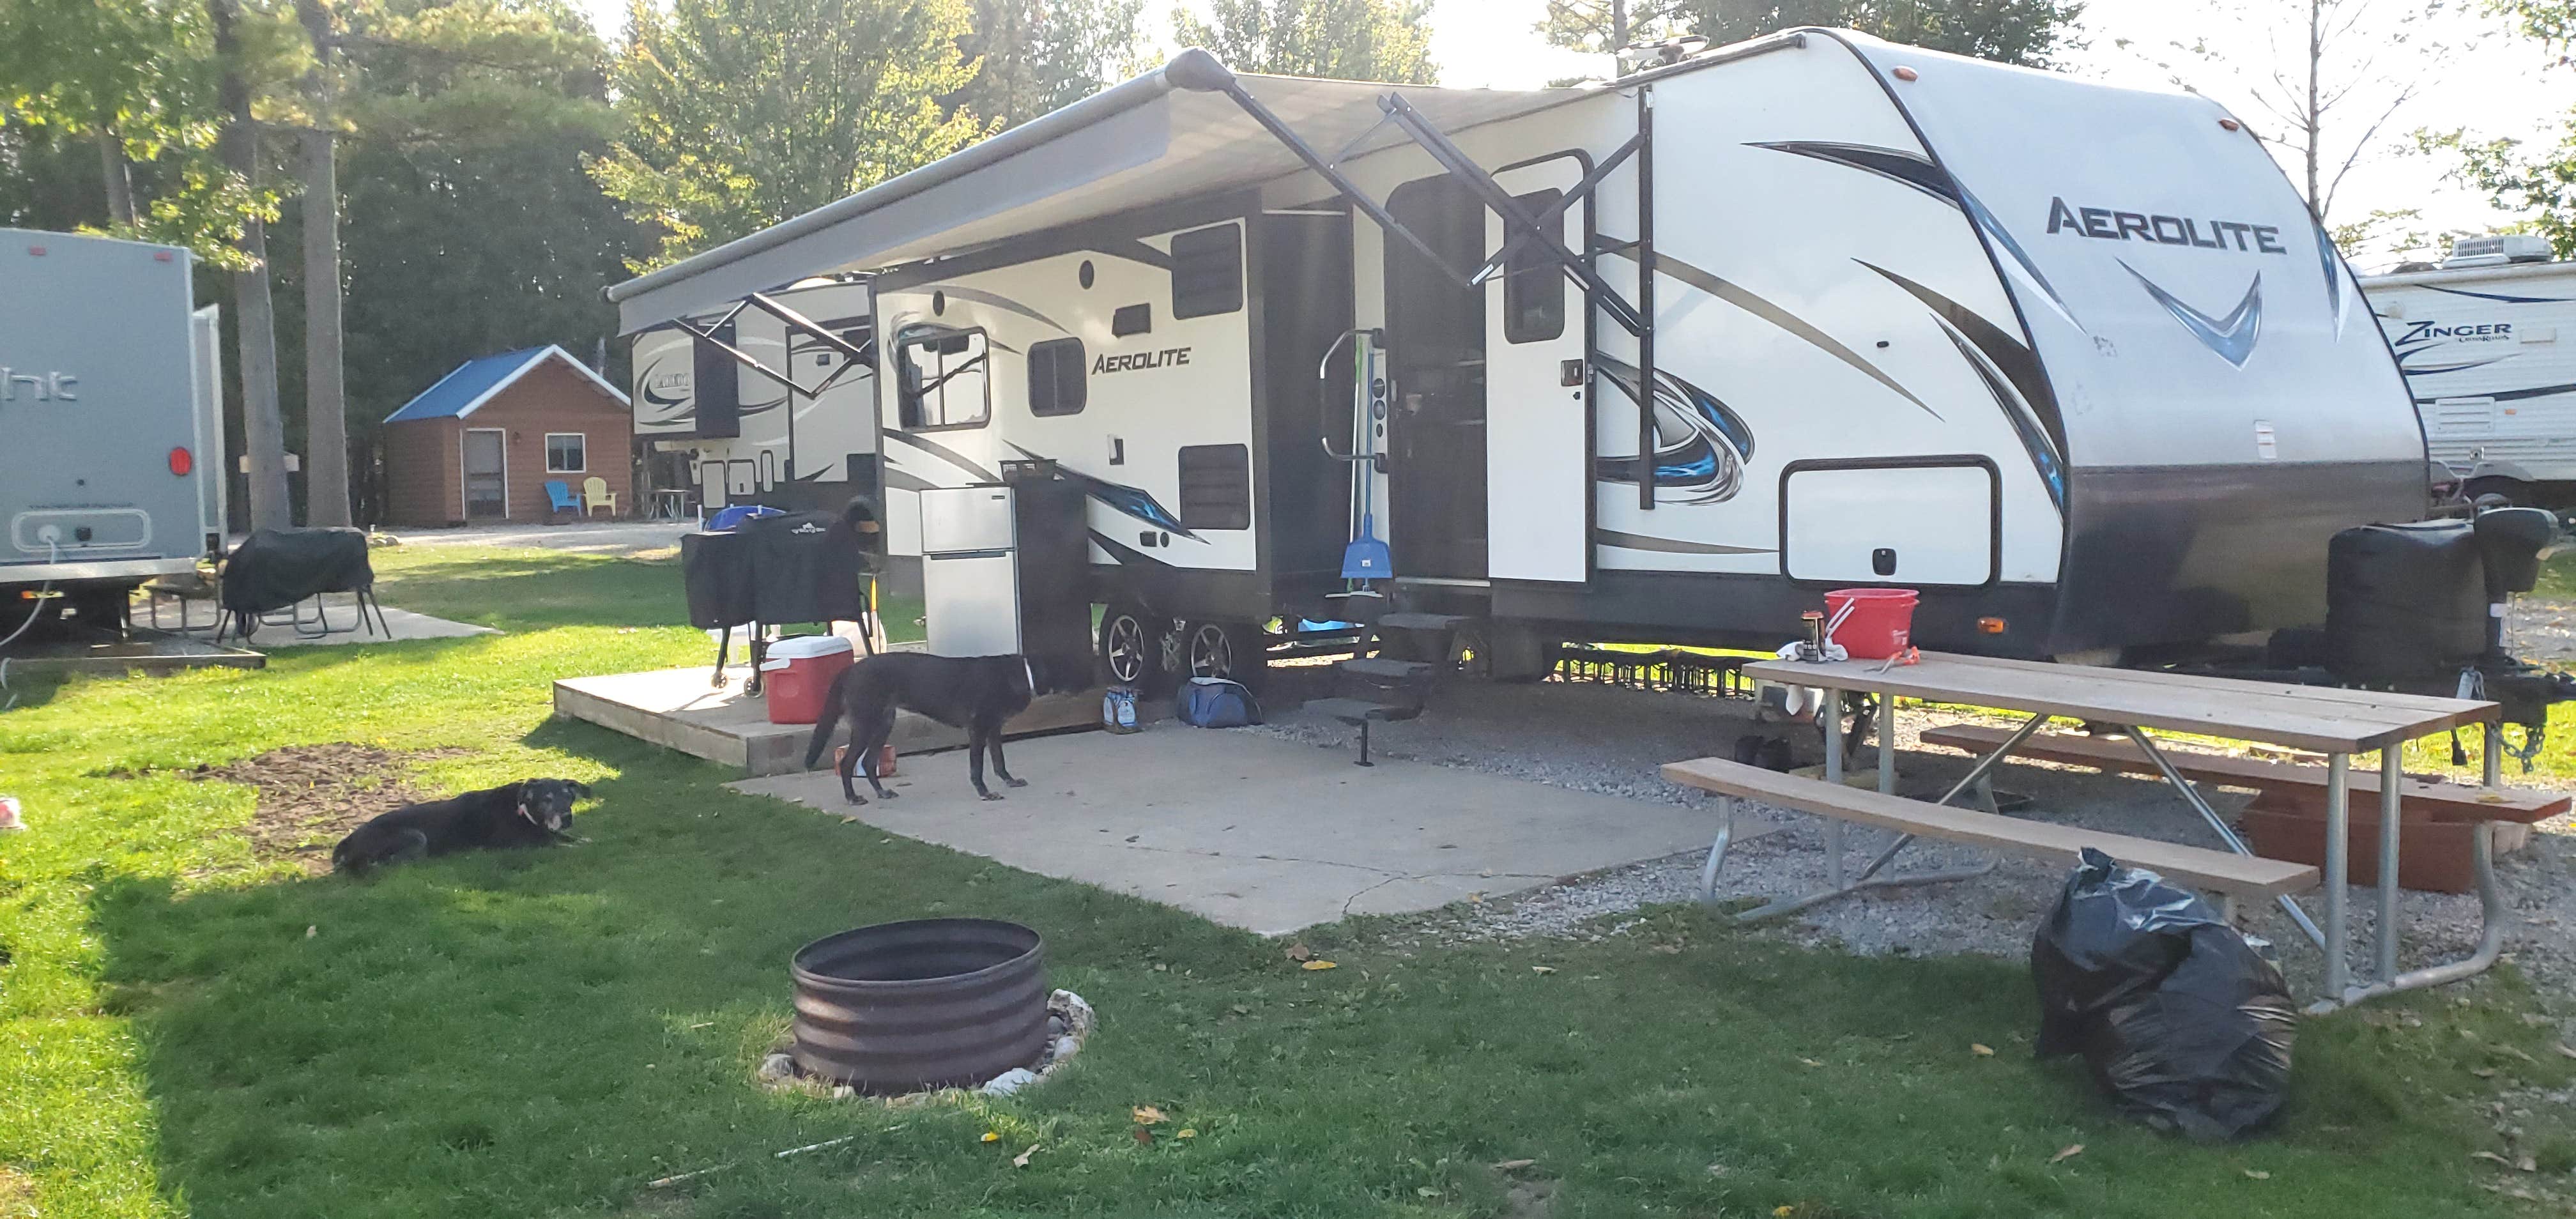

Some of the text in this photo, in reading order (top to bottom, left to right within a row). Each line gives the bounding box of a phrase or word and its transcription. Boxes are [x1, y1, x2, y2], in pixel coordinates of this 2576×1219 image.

[2046, 195, 2288, 255] AEROLITE
[2395, 320, 2512, 346] ZINGER
[1091, 346, 1192, 375] AEROLITE
